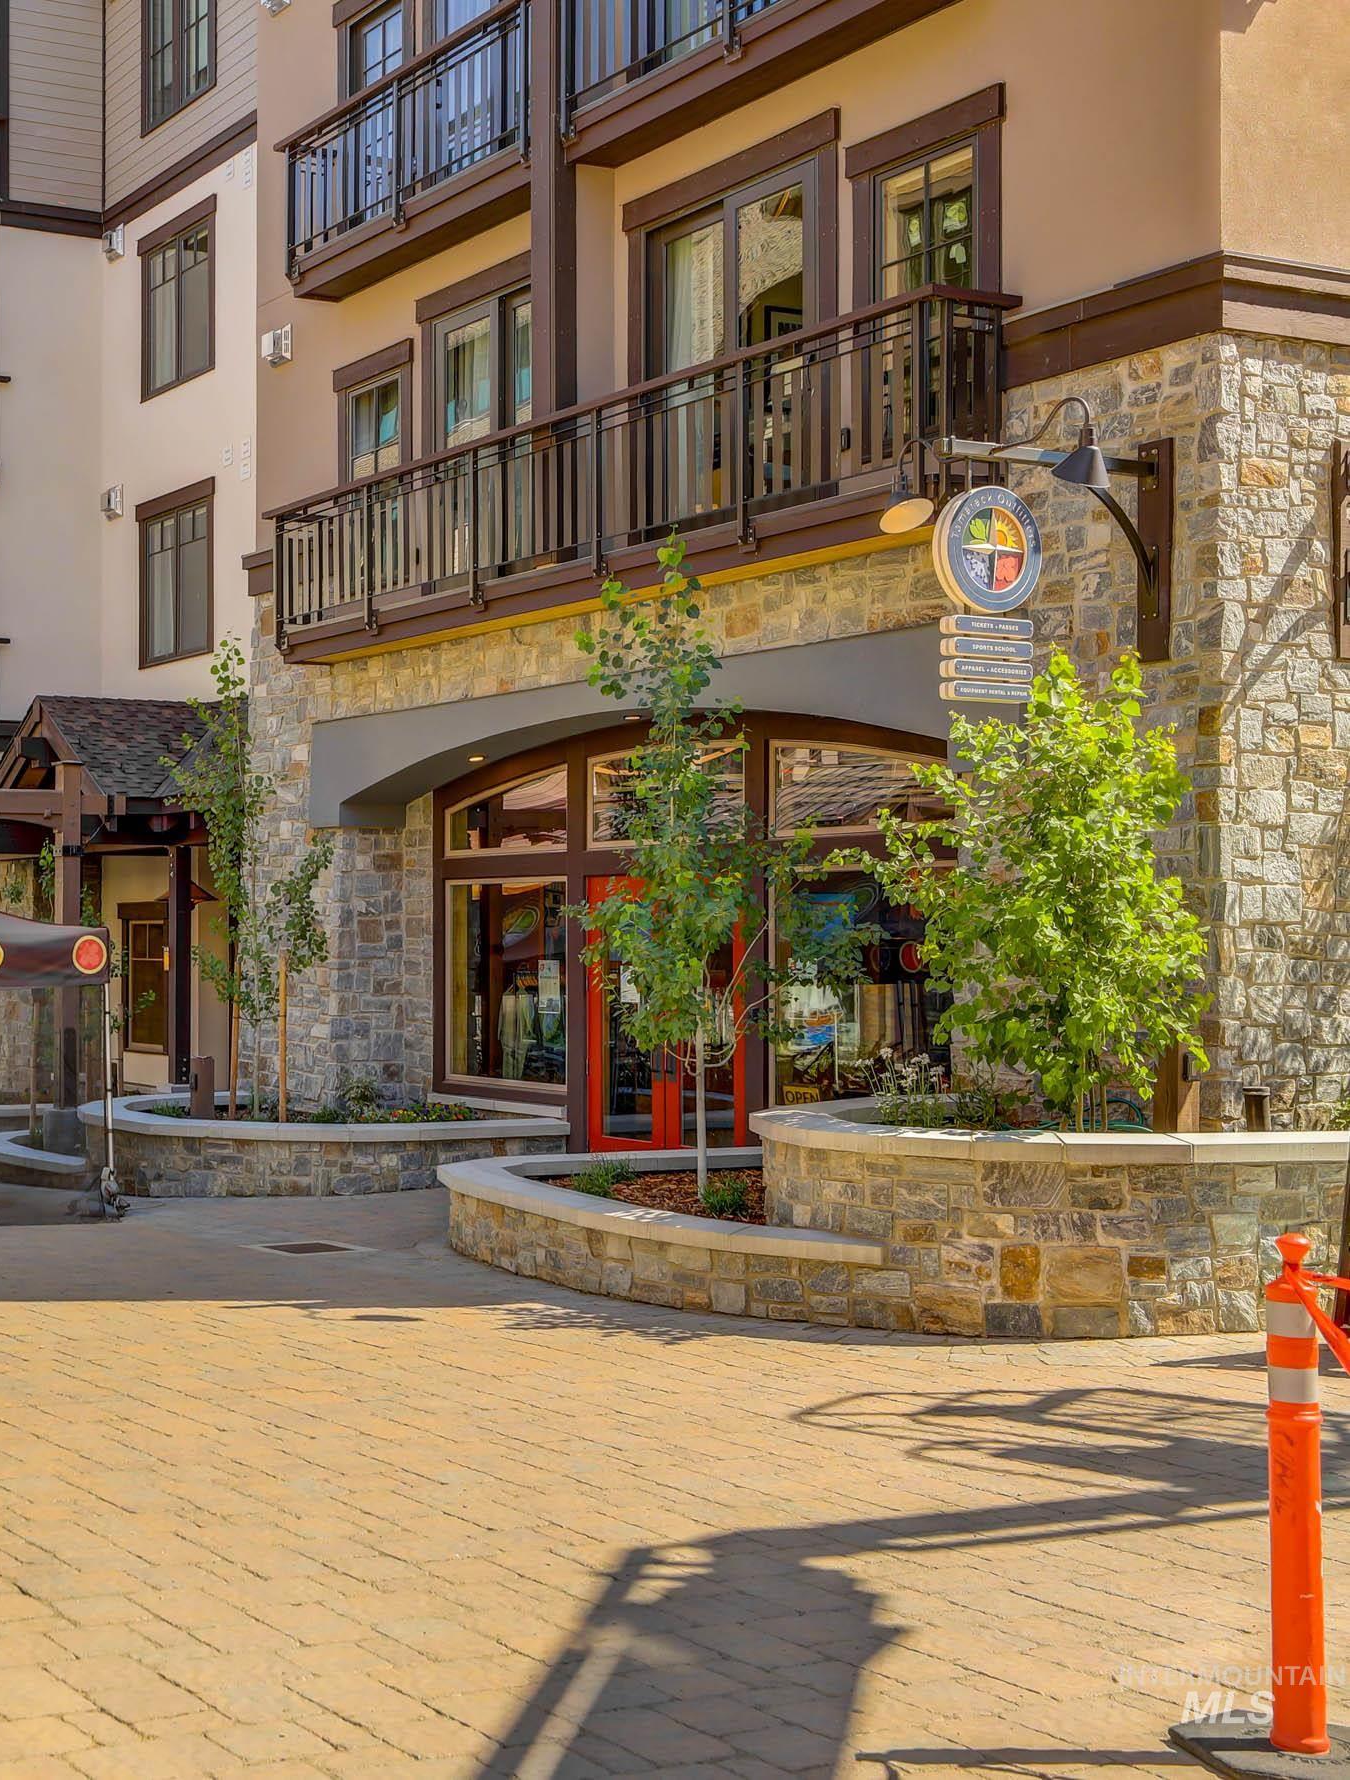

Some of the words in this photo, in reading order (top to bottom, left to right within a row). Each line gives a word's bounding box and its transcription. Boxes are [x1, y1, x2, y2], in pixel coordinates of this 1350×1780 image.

[951, 493, 993, 538] Tamarack
[971, 621, 994, 629] TICKETS
[995, 645, 1017, 653] SCHOOL
[990, 667, 1027, 675] ACCESSORIES
[785, 1090, 819, 1104] OPEN
